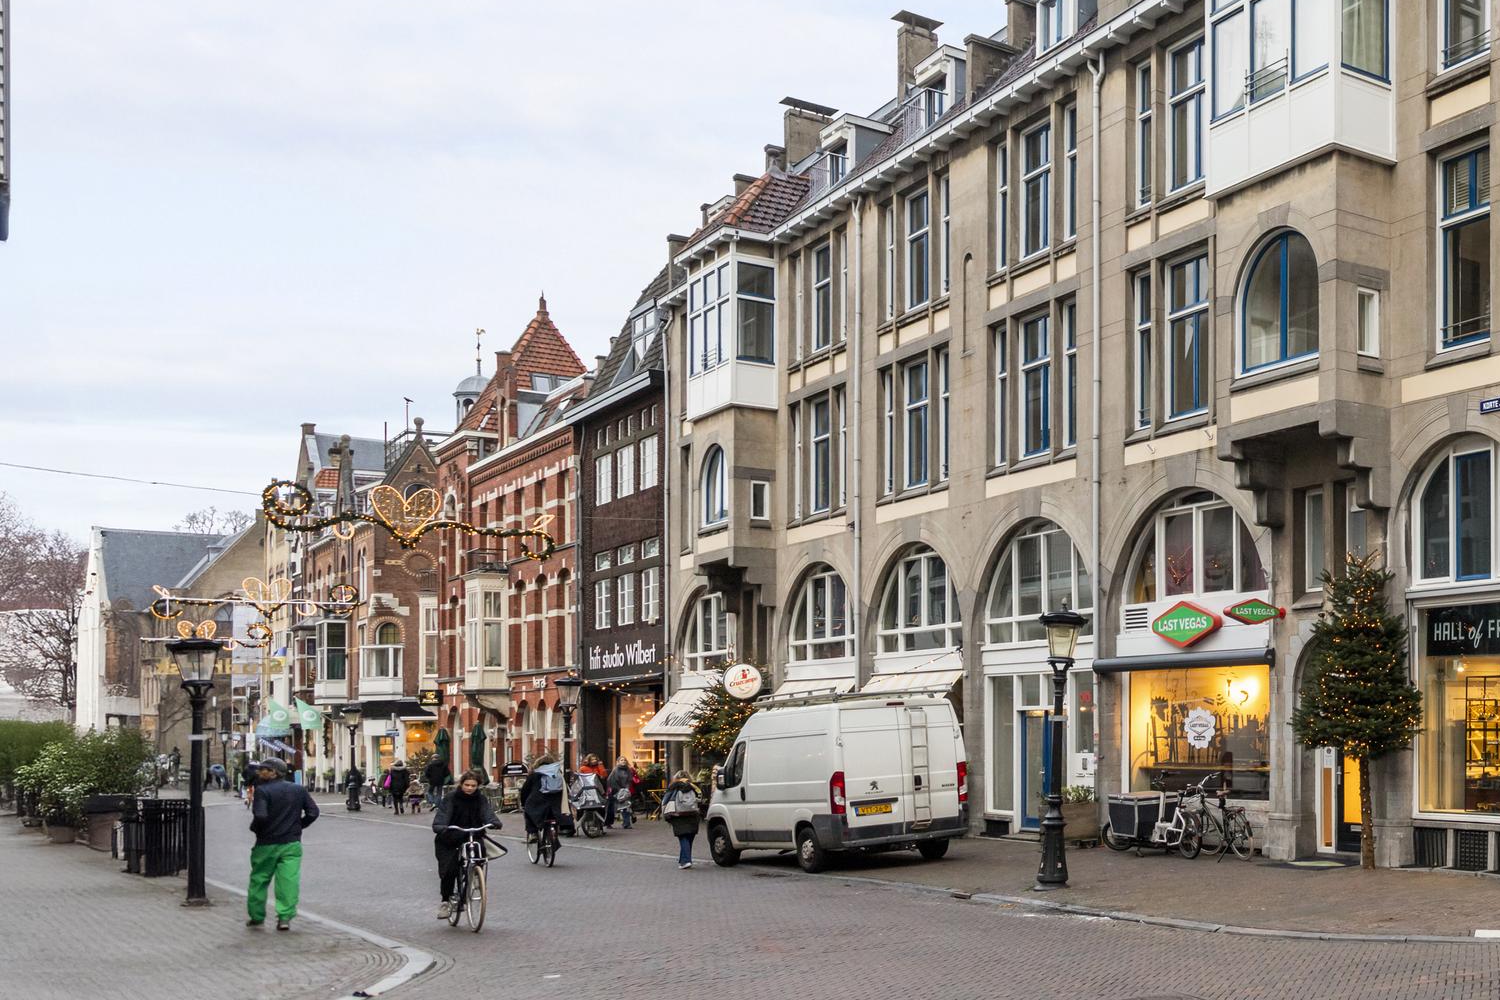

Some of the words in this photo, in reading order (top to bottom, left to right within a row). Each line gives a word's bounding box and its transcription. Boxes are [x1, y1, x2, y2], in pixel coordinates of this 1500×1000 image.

[1235, 607, 1253, 615] LAST
[1253, 607, 1275, 616] VEGAS
[1158, 619, 1178, 633] LAST
[1179, 616, 1207, 630] VEGAS
[1433, 621, 1465, 641] HALL
[1468, 619, 1483, 649] of
[589, 645, 601, 670] hifi
[602, 642, 625, 669] studio
[625, 639, 656, 667] Wilbert
